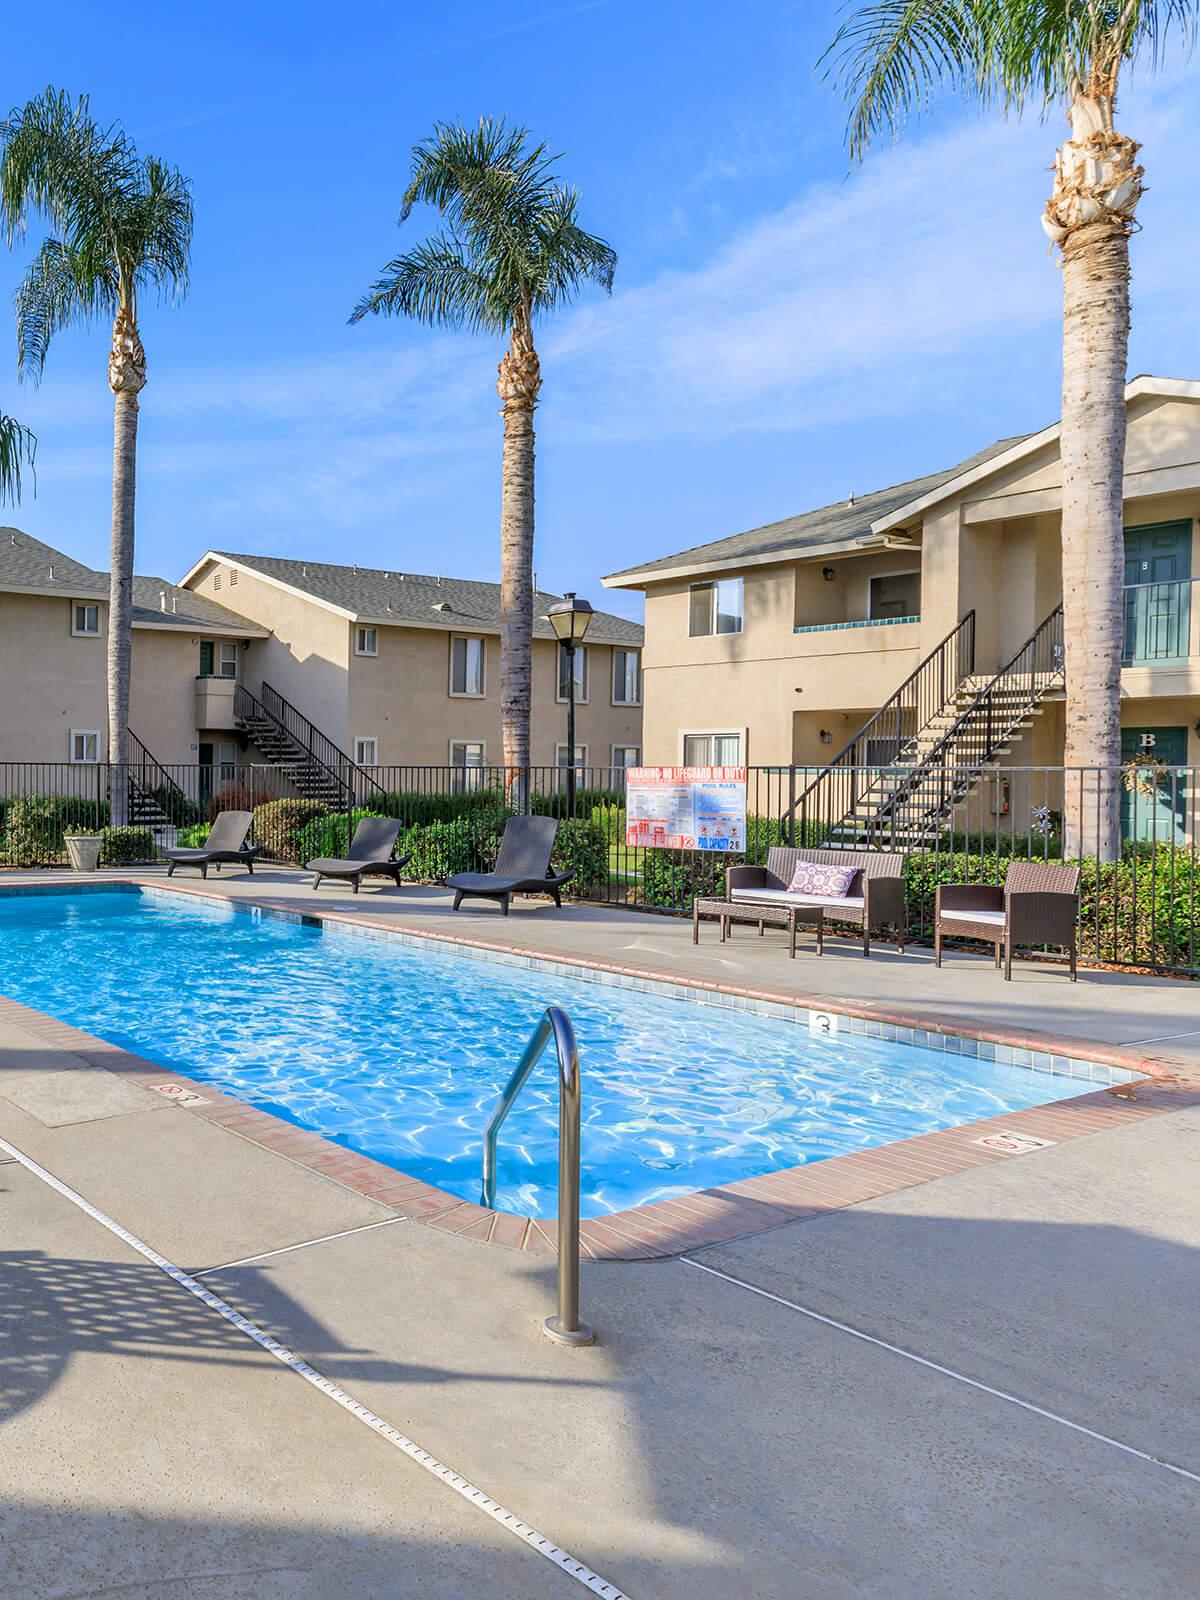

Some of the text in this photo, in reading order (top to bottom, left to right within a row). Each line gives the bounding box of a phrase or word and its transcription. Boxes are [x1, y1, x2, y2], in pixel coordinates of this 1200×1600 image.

[1139, 733, 1156, 747] B
[662, 767, 672, 779] NO
[674, 767, 712, 779] LIFEGUARD
[713, 767, 723, 779] ON
[724, 767, 745, 779] DUTY
[638, 822, 649, 833] 911
[698, 836, 708, 849] POOL
[709, 837, 728, 850] CAPACITY
